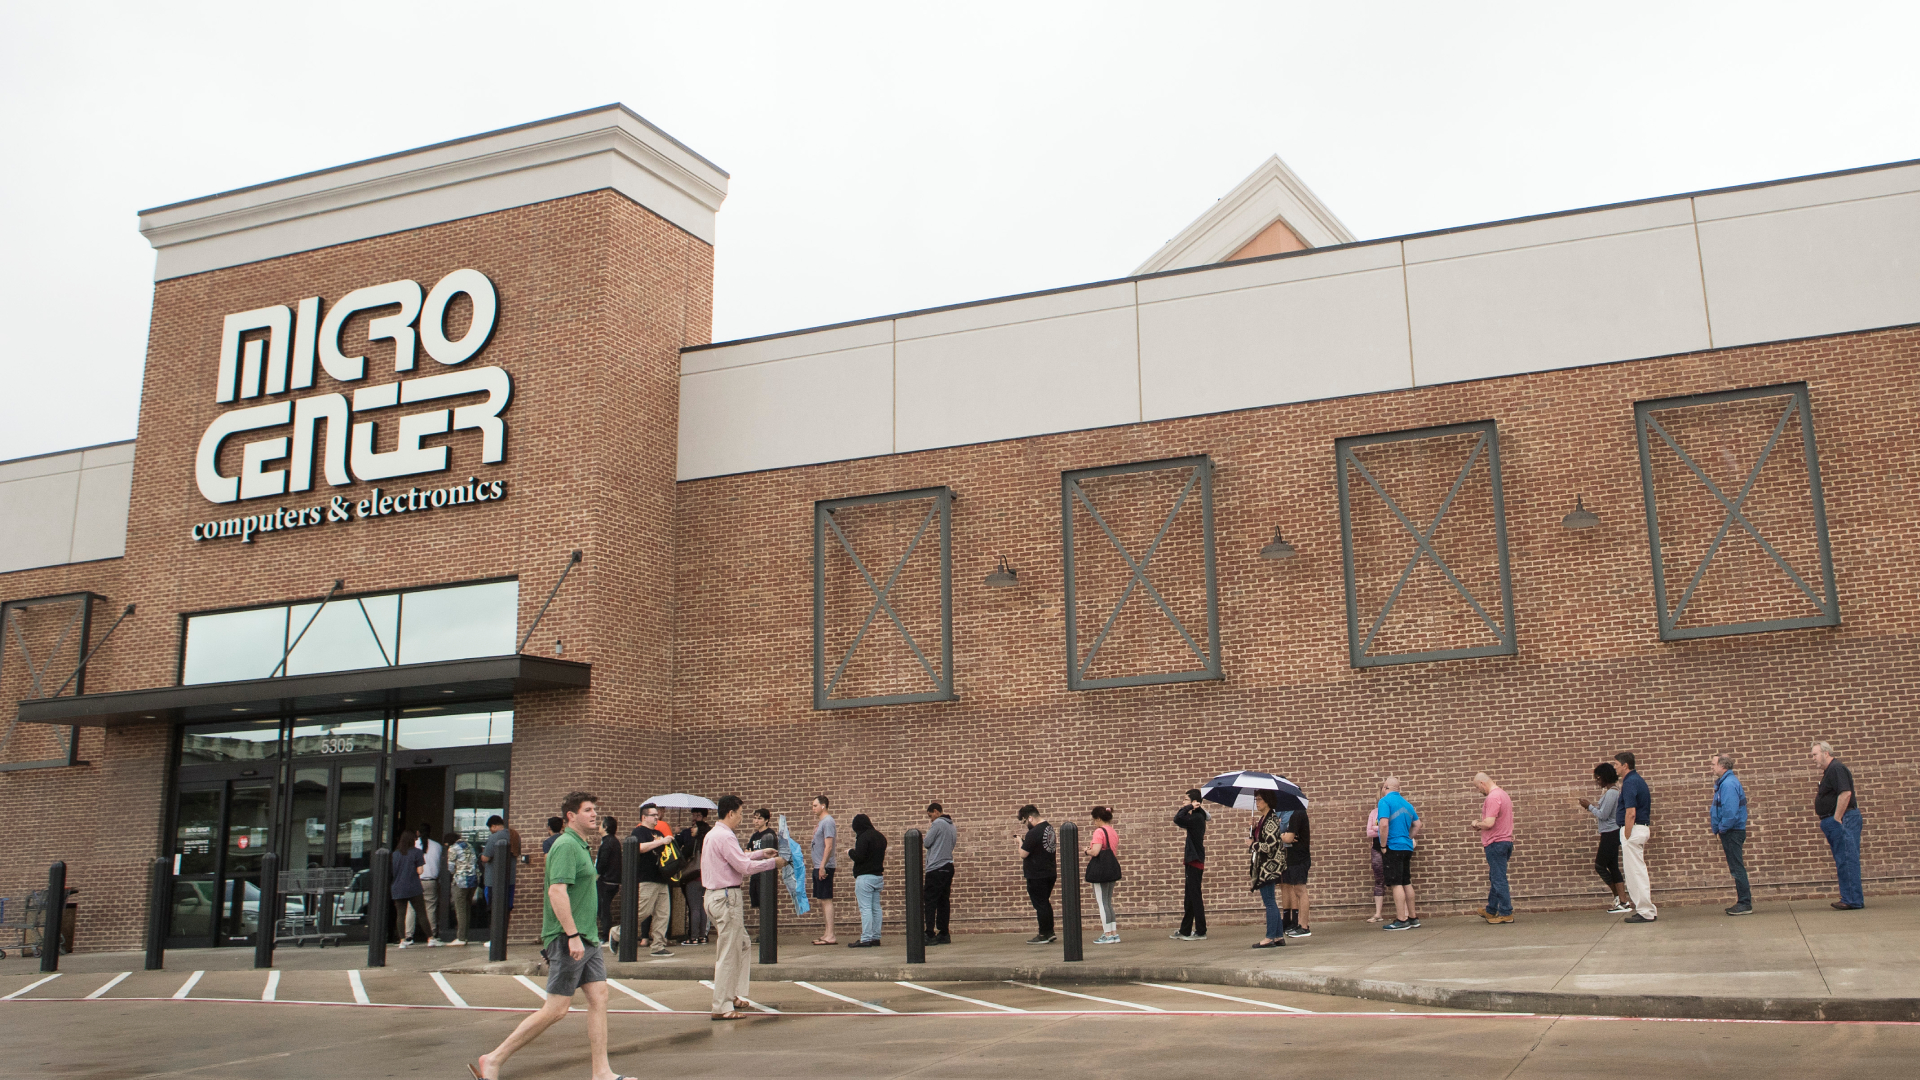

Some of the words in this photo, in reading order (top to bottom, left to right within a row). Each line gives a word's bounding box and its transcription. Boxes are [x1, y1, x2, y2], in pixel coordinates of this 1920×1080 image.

[216, 268, 498, 403] MICRO
[195, 365, 511, 504] CENTER
[191, 506, 322, 543] computers
[327, 495, 350, 522] &
[356, 476, 503, 518] electronics
[321, 738, 354, 754] 5305
